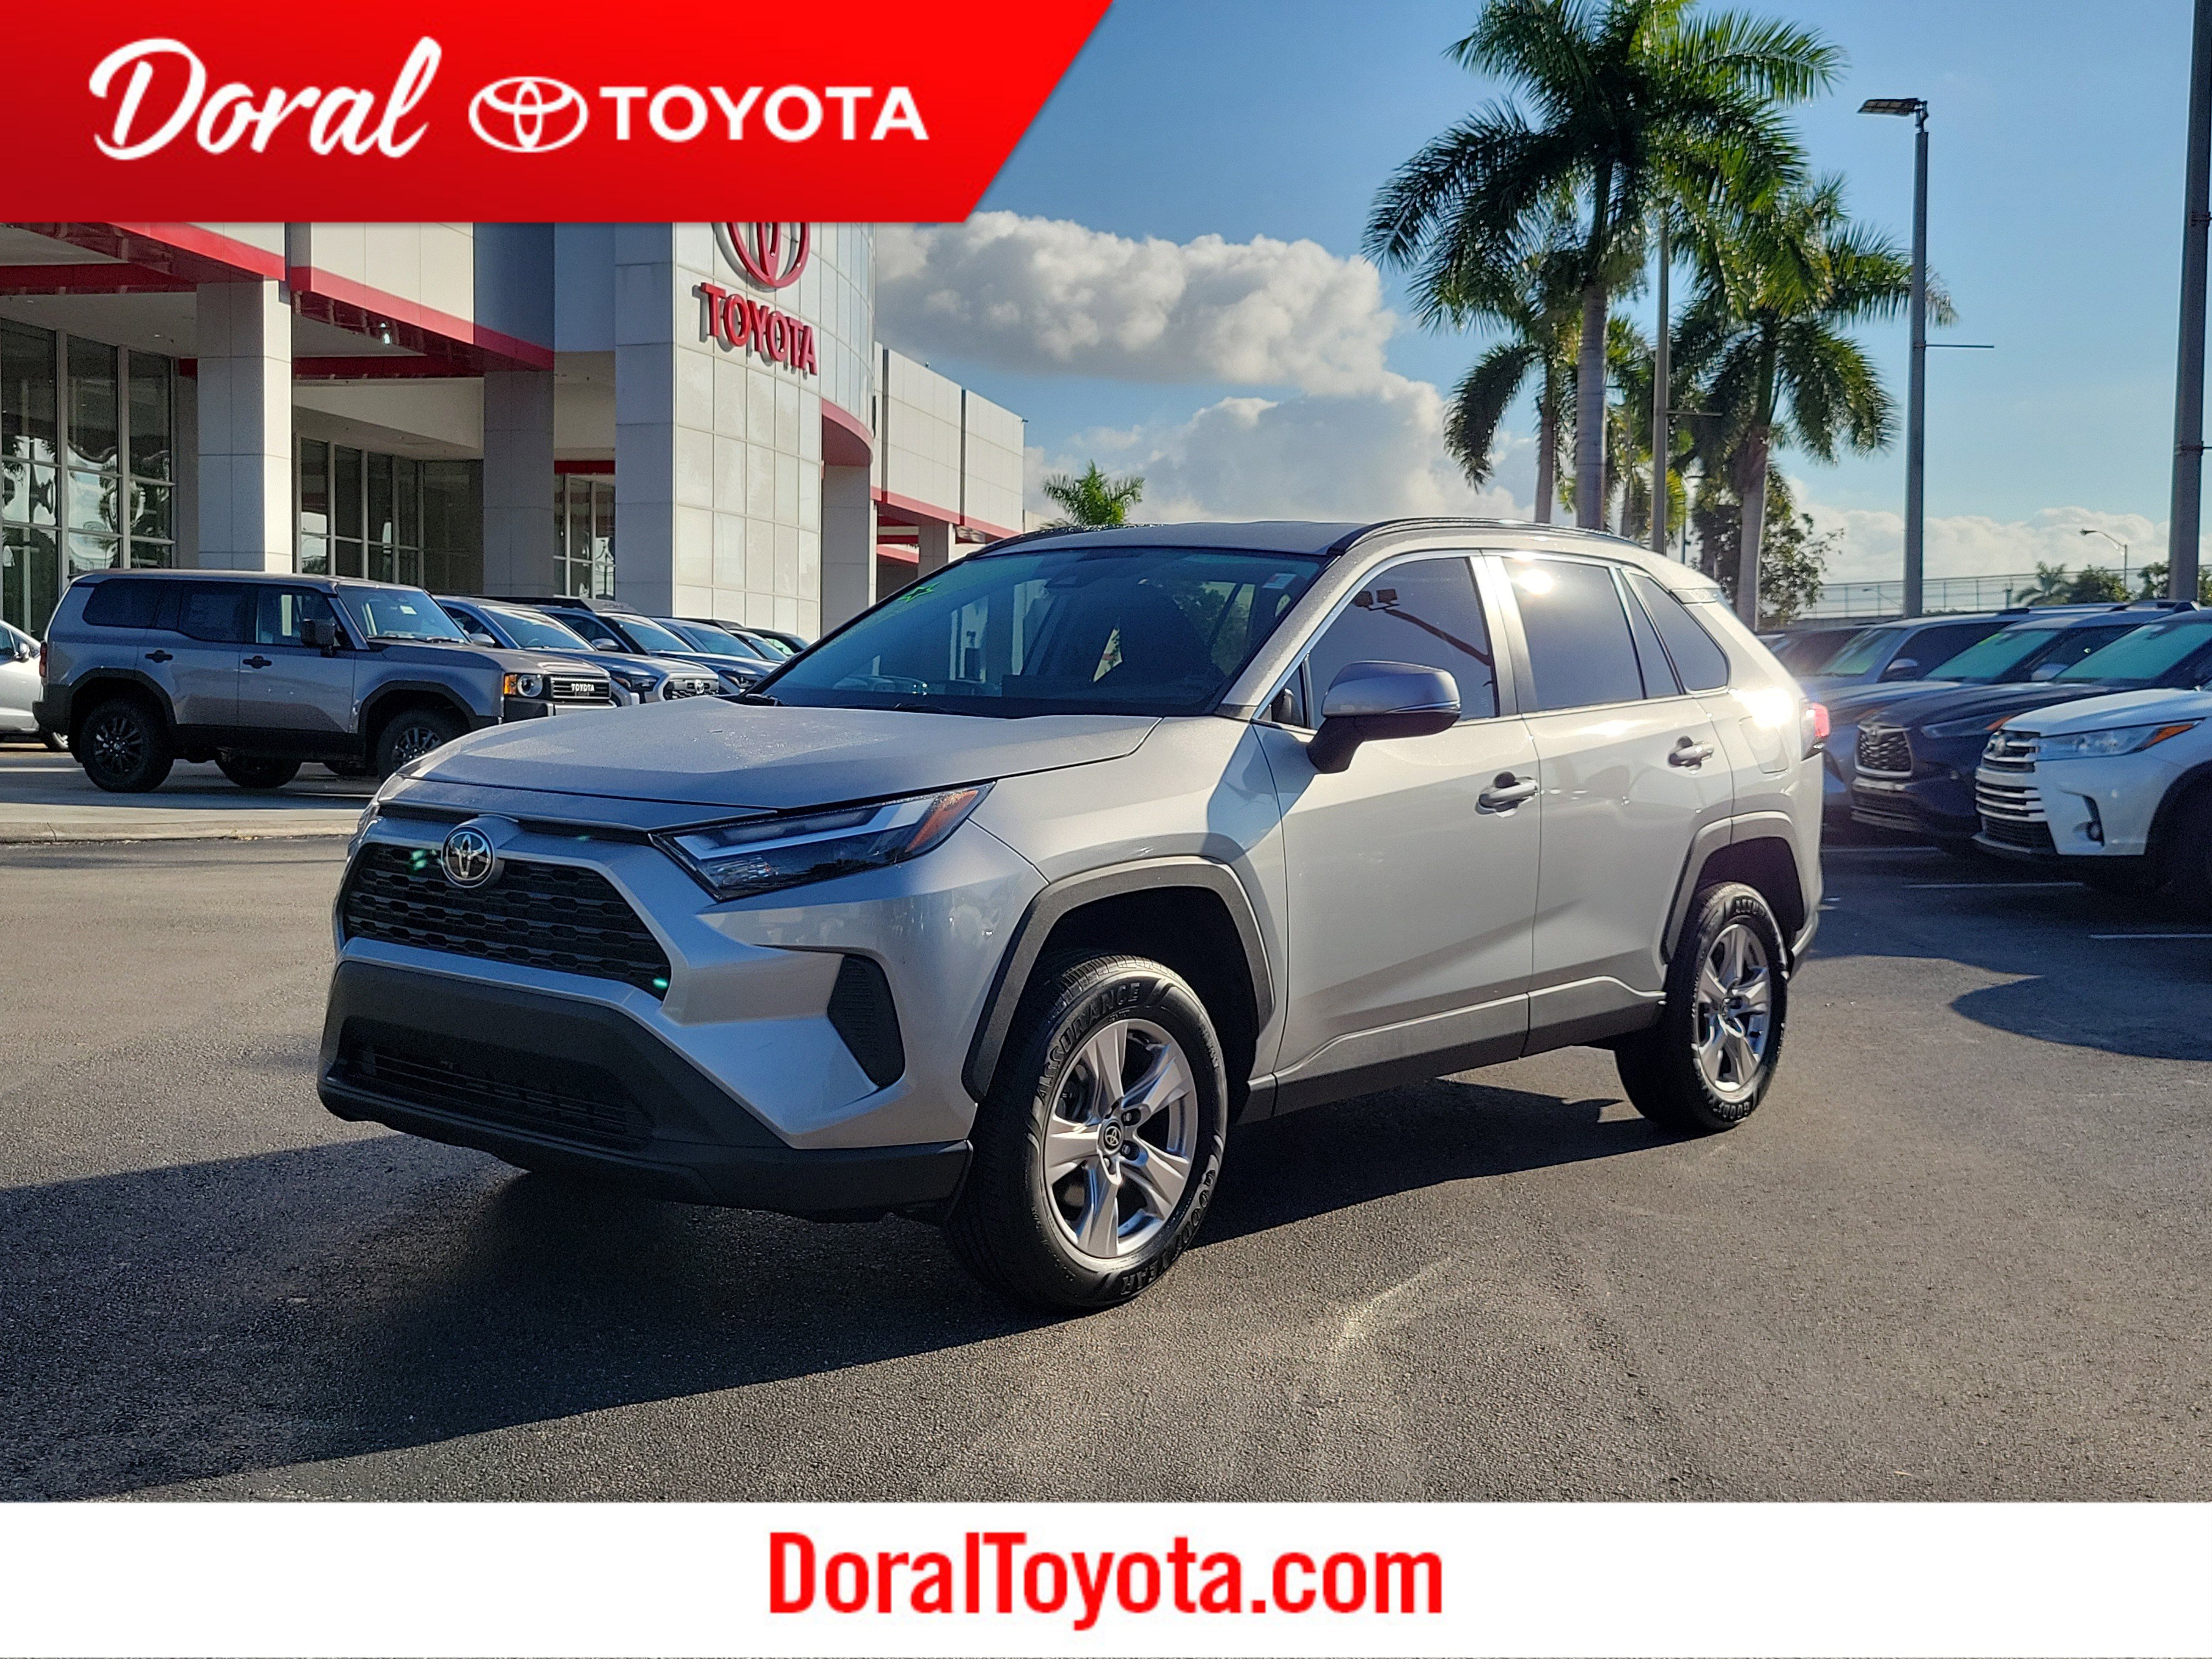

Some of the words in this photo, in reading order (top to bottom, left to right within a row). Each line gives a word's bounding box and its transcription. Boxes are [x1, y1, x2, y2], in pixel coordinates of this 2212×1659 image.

[701, 282, 817, 375] TOYOTA
[571, 683, 595, 692] TOYOTA
[1036, 982, 1141, 1106] ASSURANCE
